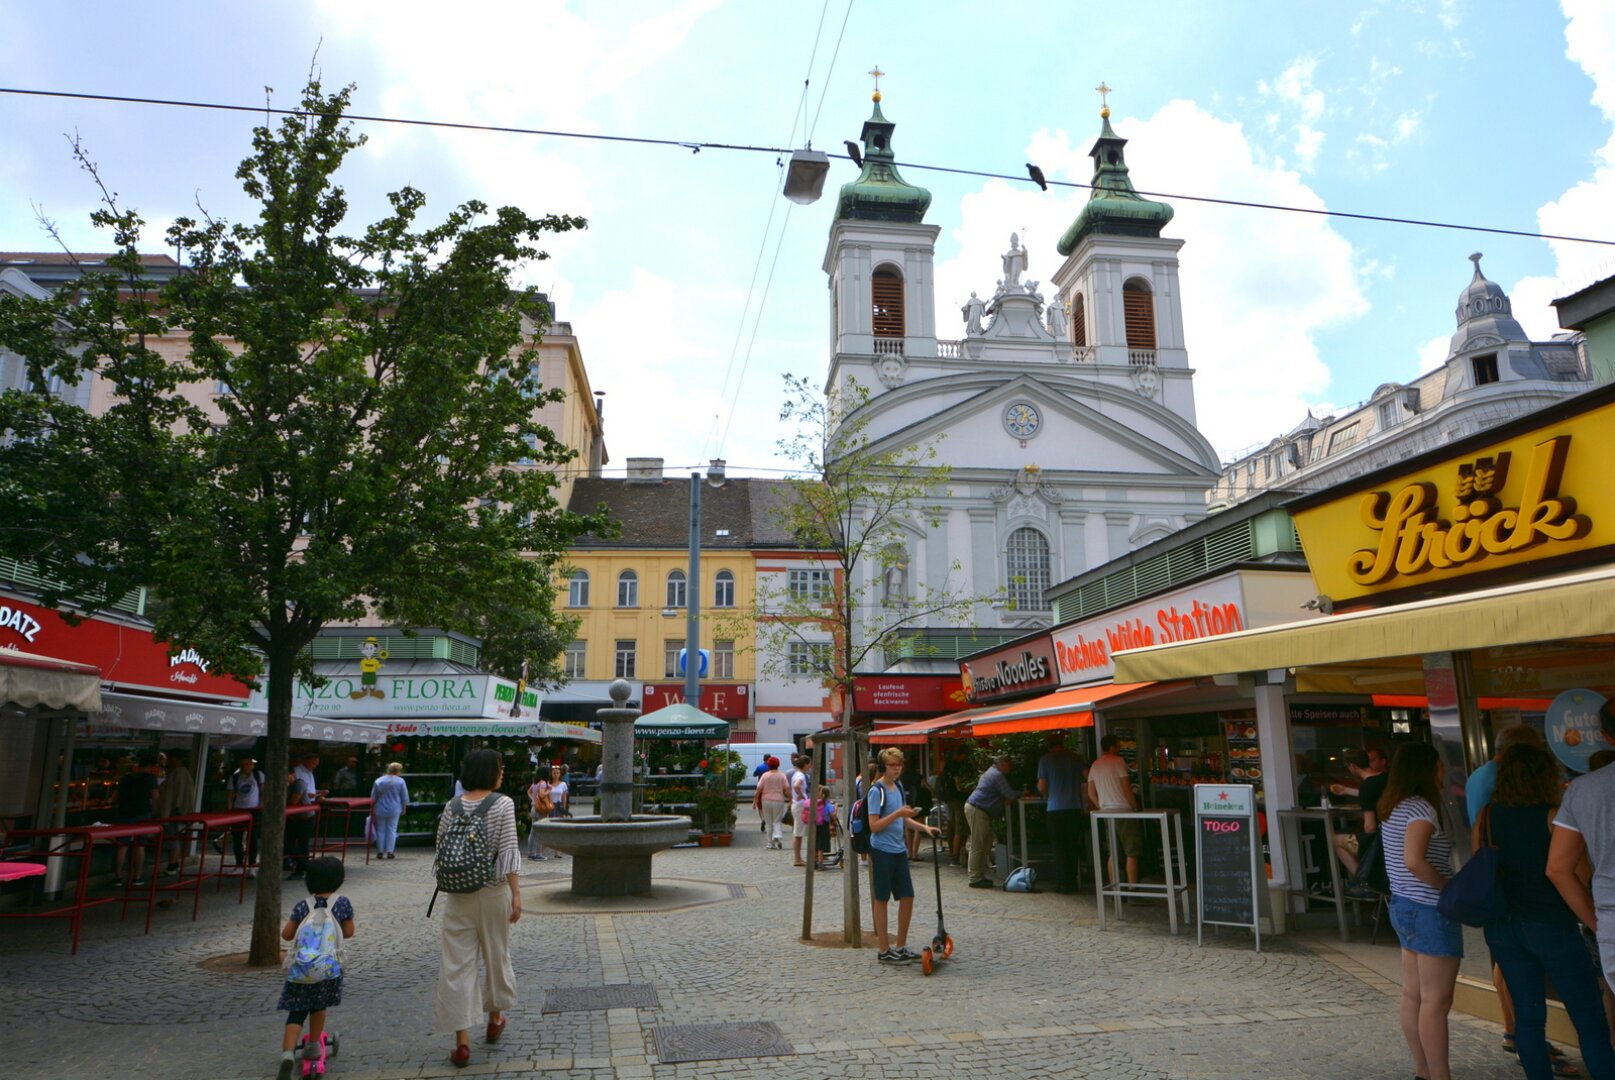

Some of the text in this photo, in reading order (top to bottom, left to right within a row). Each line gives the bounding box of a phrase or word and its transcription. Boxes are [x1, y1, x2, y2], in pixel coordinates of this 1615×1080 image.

[1347, 438, 1578, 586] Ströck
[1056, 600, 1244, 674] Rochus Wilde Station
[995, 652, 1046, 687] Noodles
[391, 678, 477, 700] FLORA
[394, 703, 471, 713] www.penzo-flora.at
[1304, 709, 1338, 720] Speisen
[1339, 709, 1360, 718] auch
[433, 723, 527, 734] www.penzo-flora.at
[634, 726, 716, 736] www.penzo-flora.at
[1203, 802, 1245, 811] Heineken
